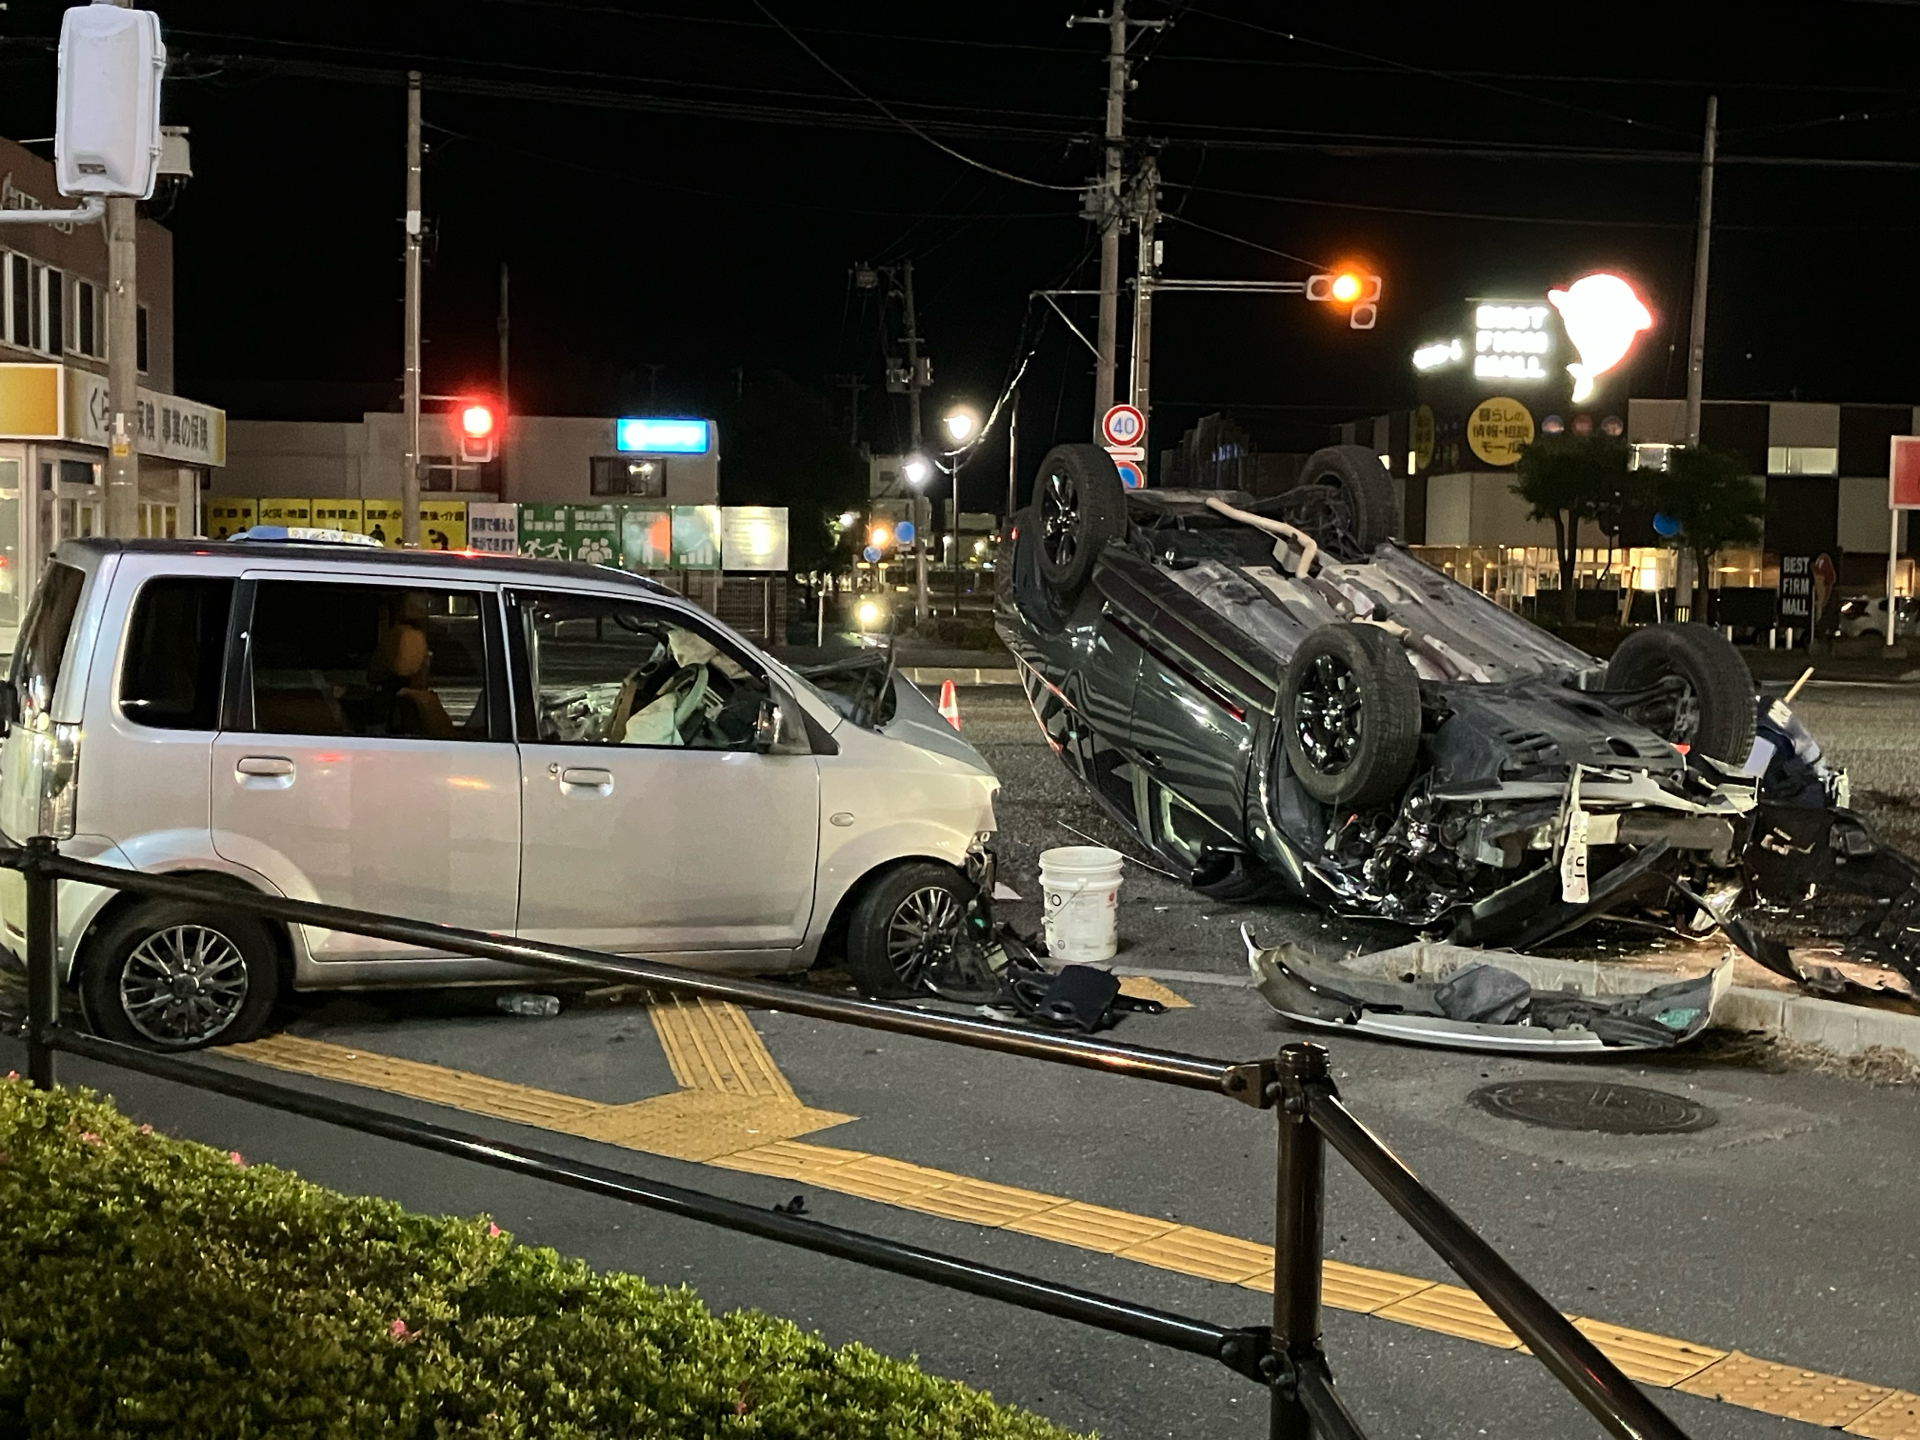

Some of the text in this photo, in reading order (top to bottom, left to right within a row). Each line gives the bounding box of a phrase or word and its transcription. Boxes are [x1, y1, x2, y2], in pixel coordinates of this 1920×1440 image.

[1479, 408, 1525, 422] 暮らしの
[1113, 417, 1135, 434] 40
[1783, 556, 1810, 574] BEST
[1783, 577, 1810, 595] FIRM
[1782, 598, 1809, 615] MALL
